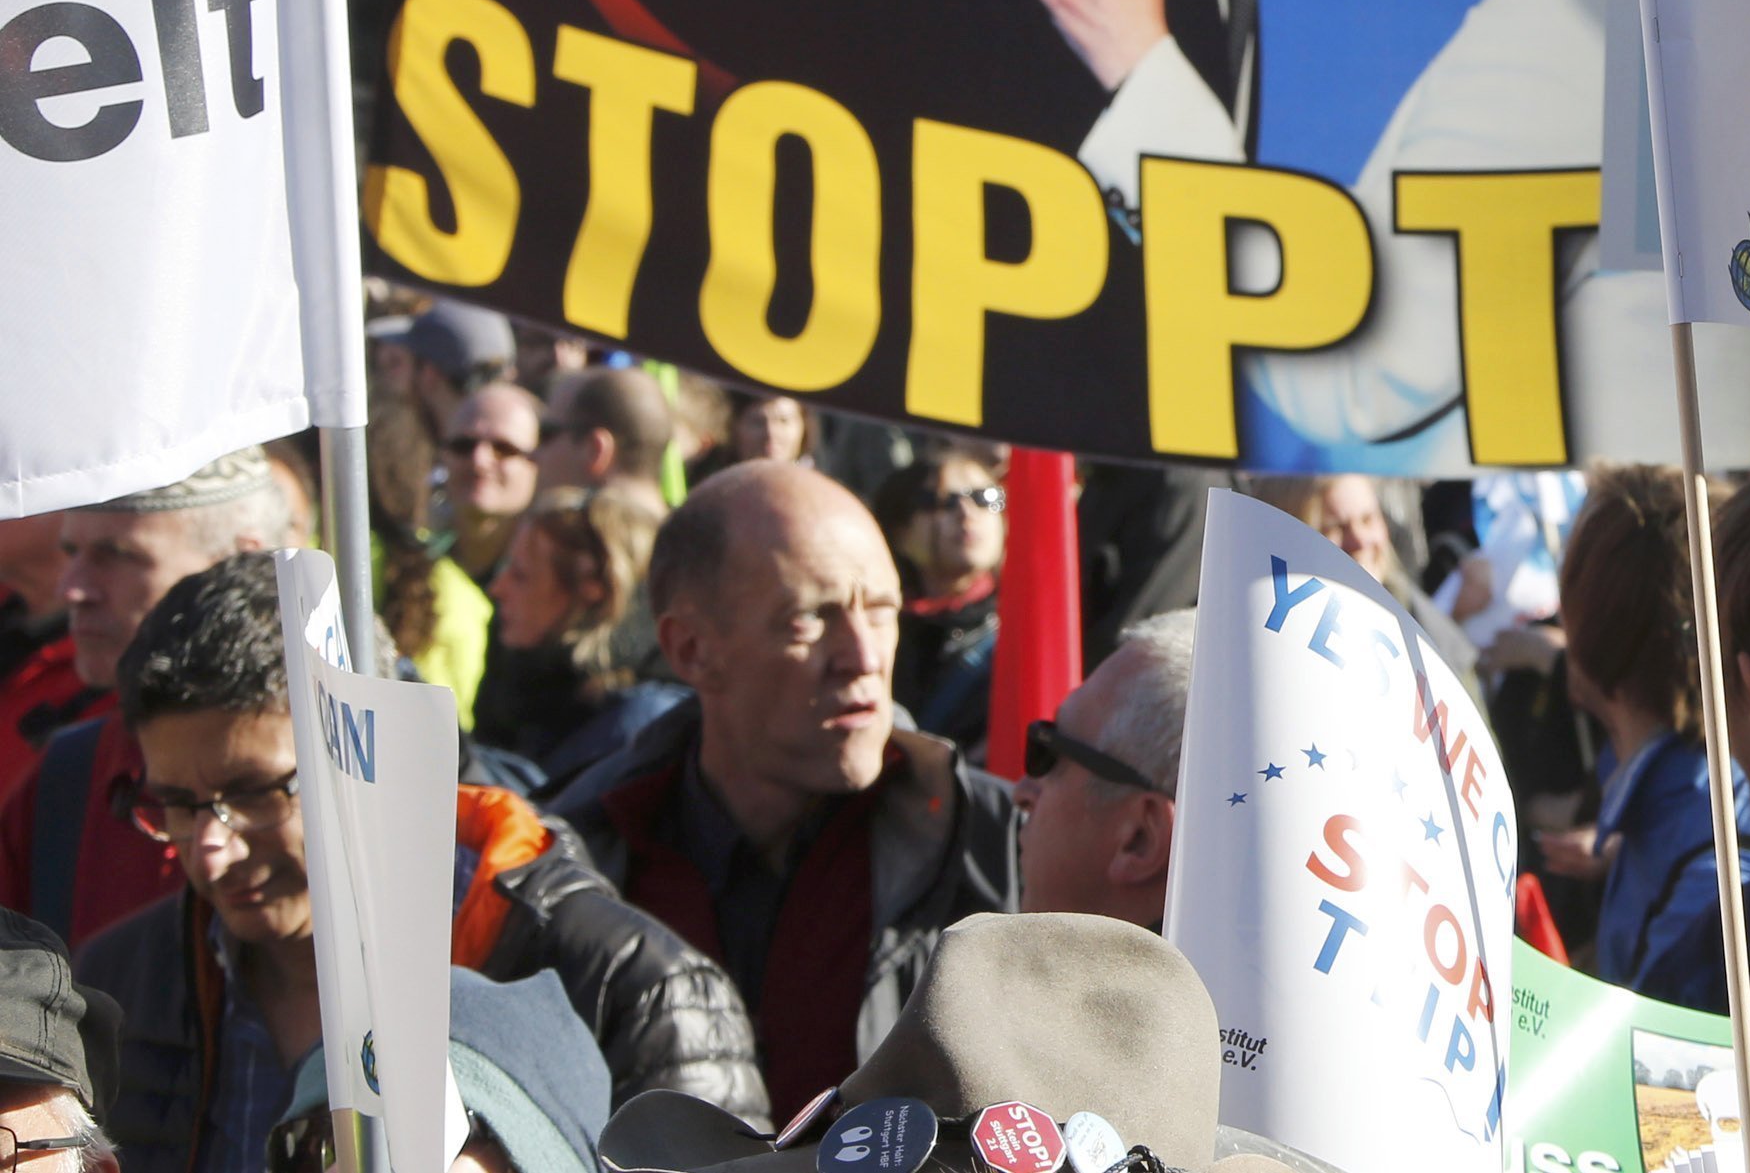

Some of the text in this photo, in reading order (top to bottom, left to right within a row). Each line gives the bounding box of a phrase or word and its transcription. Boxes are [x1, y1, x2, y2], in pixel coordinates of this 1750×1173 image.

[1412, 670, 1487, 821] WE
[1512, 987, 1551, 1020] stitut
[1518, 1015, 1546, 1039] e.V.
[1222, 1050, 1256, 1071] e.V.
[986, 1137, 999, 1151] 21
[989, 1120, 1018, 1164] Stuttgart
[1005, 1128, 1021, 1151] Kein
[1008, 1105, 1053, 1169] STOP!
